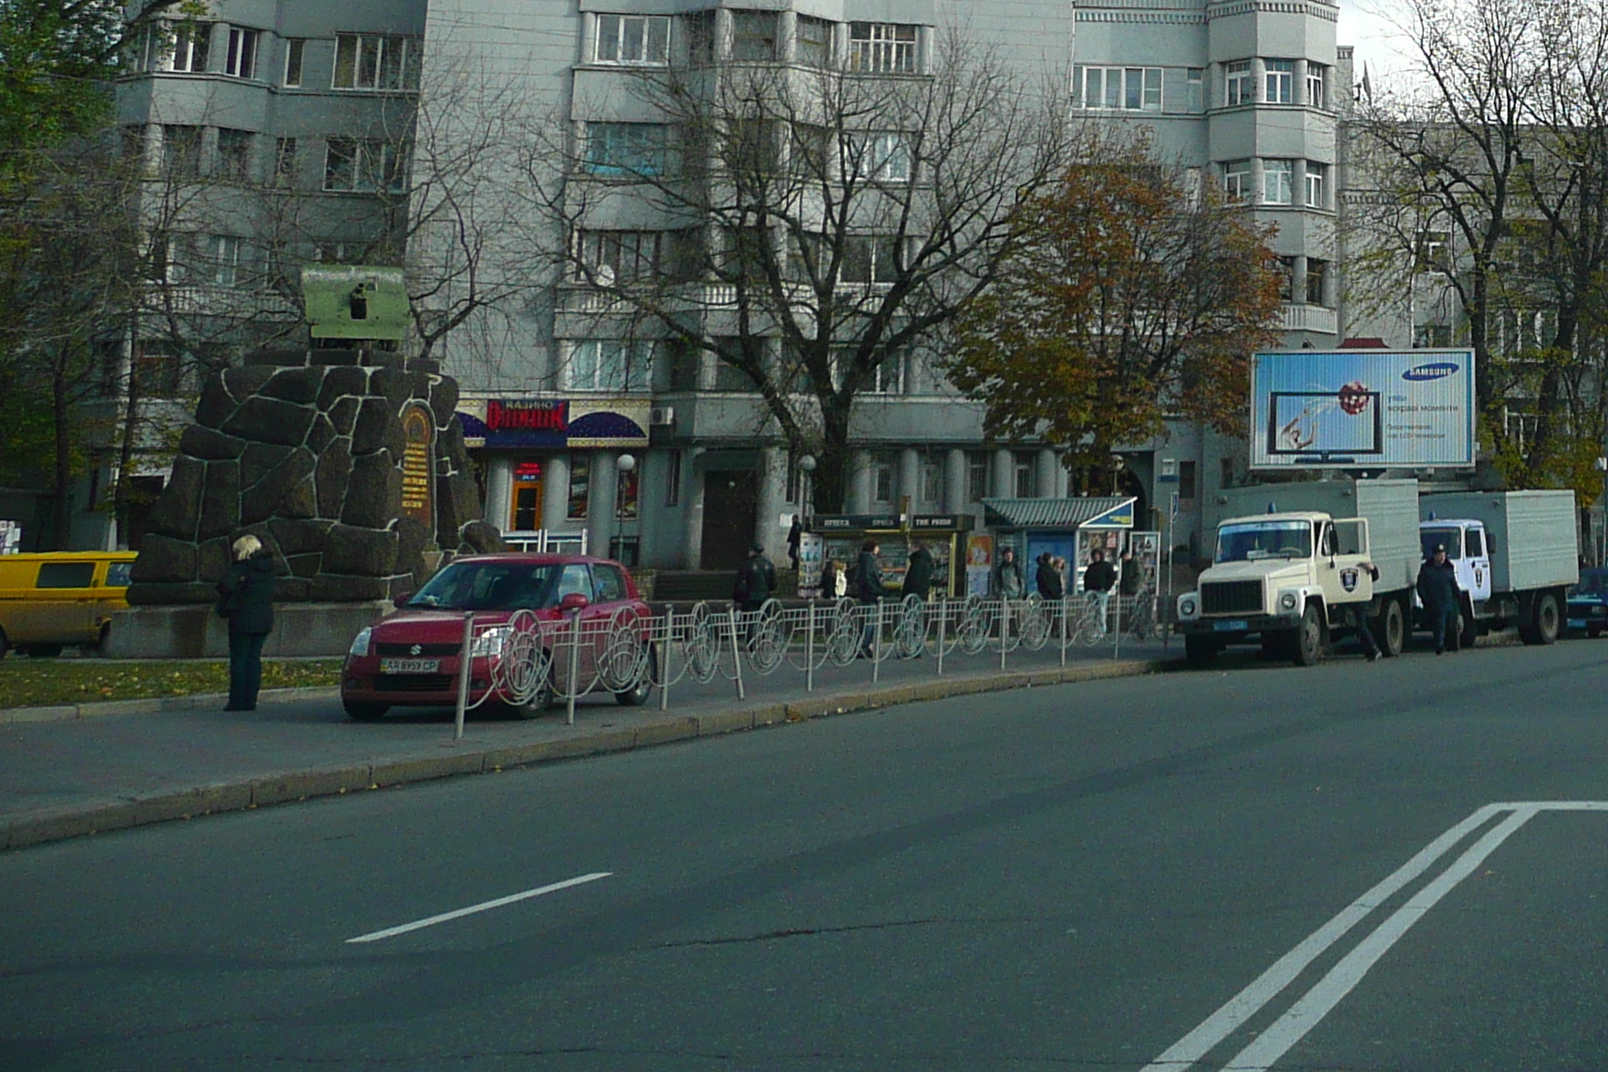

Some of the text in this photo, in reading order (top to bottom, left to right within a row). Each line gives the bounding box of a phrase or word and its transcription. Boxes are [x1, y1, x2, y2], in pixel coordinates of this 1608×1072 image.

[1409, 367, 1453, 377] SAMSUNG
[505, 399, 555, 410] КАЗИНО
[915, 517, 929, 526] THE
